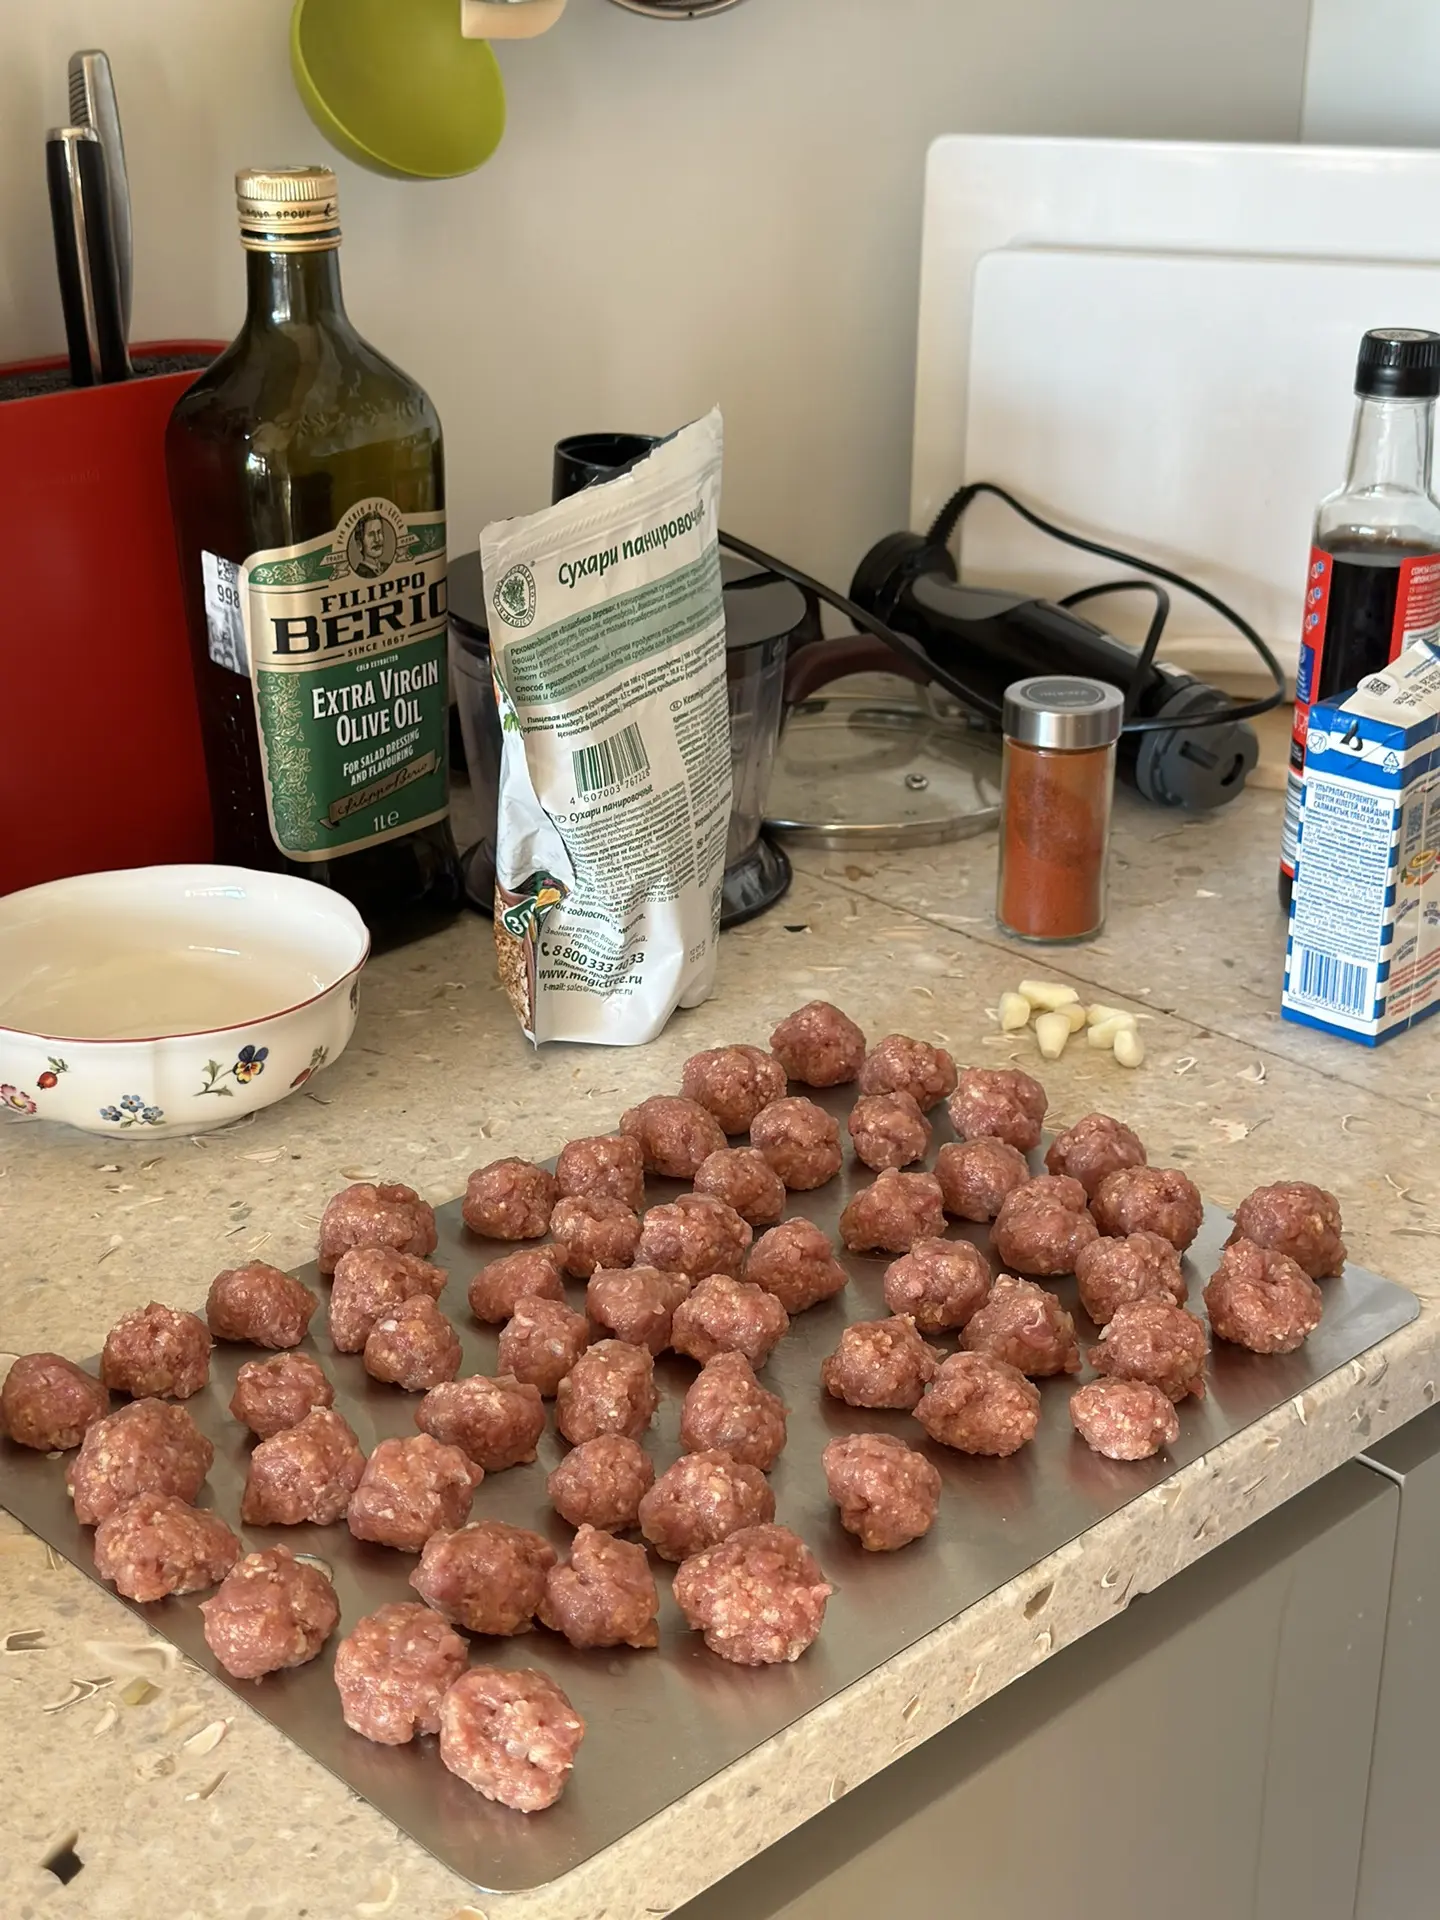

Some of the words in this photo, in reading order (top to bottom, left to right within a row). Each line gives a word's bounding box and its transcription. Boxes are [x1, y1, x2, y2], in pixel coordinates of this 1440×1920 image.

[326, 554, 344, 562] TRADE
[558, 544, 619, 589] Сухари
[320, 571, 425, 614] FILIPPO
[348, 638, 378, 657] SINCE
[382, 634, 405, 648] 1867
[356, 662, 370, 673] COLD
[371, 655, 399, 669] EXTRACTED
[511, 653, 536, 666] овощи
[515, 682, 544, 693] Способ
[527, 713, 560, 725] Пищевая
[561, 703, 589, 721] ценность
[557, 724, 591, 739] ценность
[343, 760, 360, 777] FOR
[361, 747, 385, 769] SALAD
[386, 728, 420, 757] DRESSING
[350, 770, 368, 787] AND
[369, 745, 414, 780] FLAVOURING
[569, 796, 576, 806] 4
[583, 784, 621, 803] 607003
[569, 804, 601, 824] Сухари
[602, 783, 654, 814] панировочные
[597, 850, 620, 864] воздуха
[606, 865, 623, 874] Адрес
[567, 908, 611, 924] годности
[545, 926, 572, 938] Звонок
[571, 932, 583, 940] по
[582, 935, 607, 951] России
[558, 925, 575, 933] Нам
[575, 926, 600, 939] важно
[599, 931, 620, 949] Ваше
[552, 945, 563, 956] 8
[562, 947, 588, 966] 800
[587, 957, 614, 973] 333
[553, 957, 588, 974] Каталог
[543, 982, 567, 991] E-mail:
